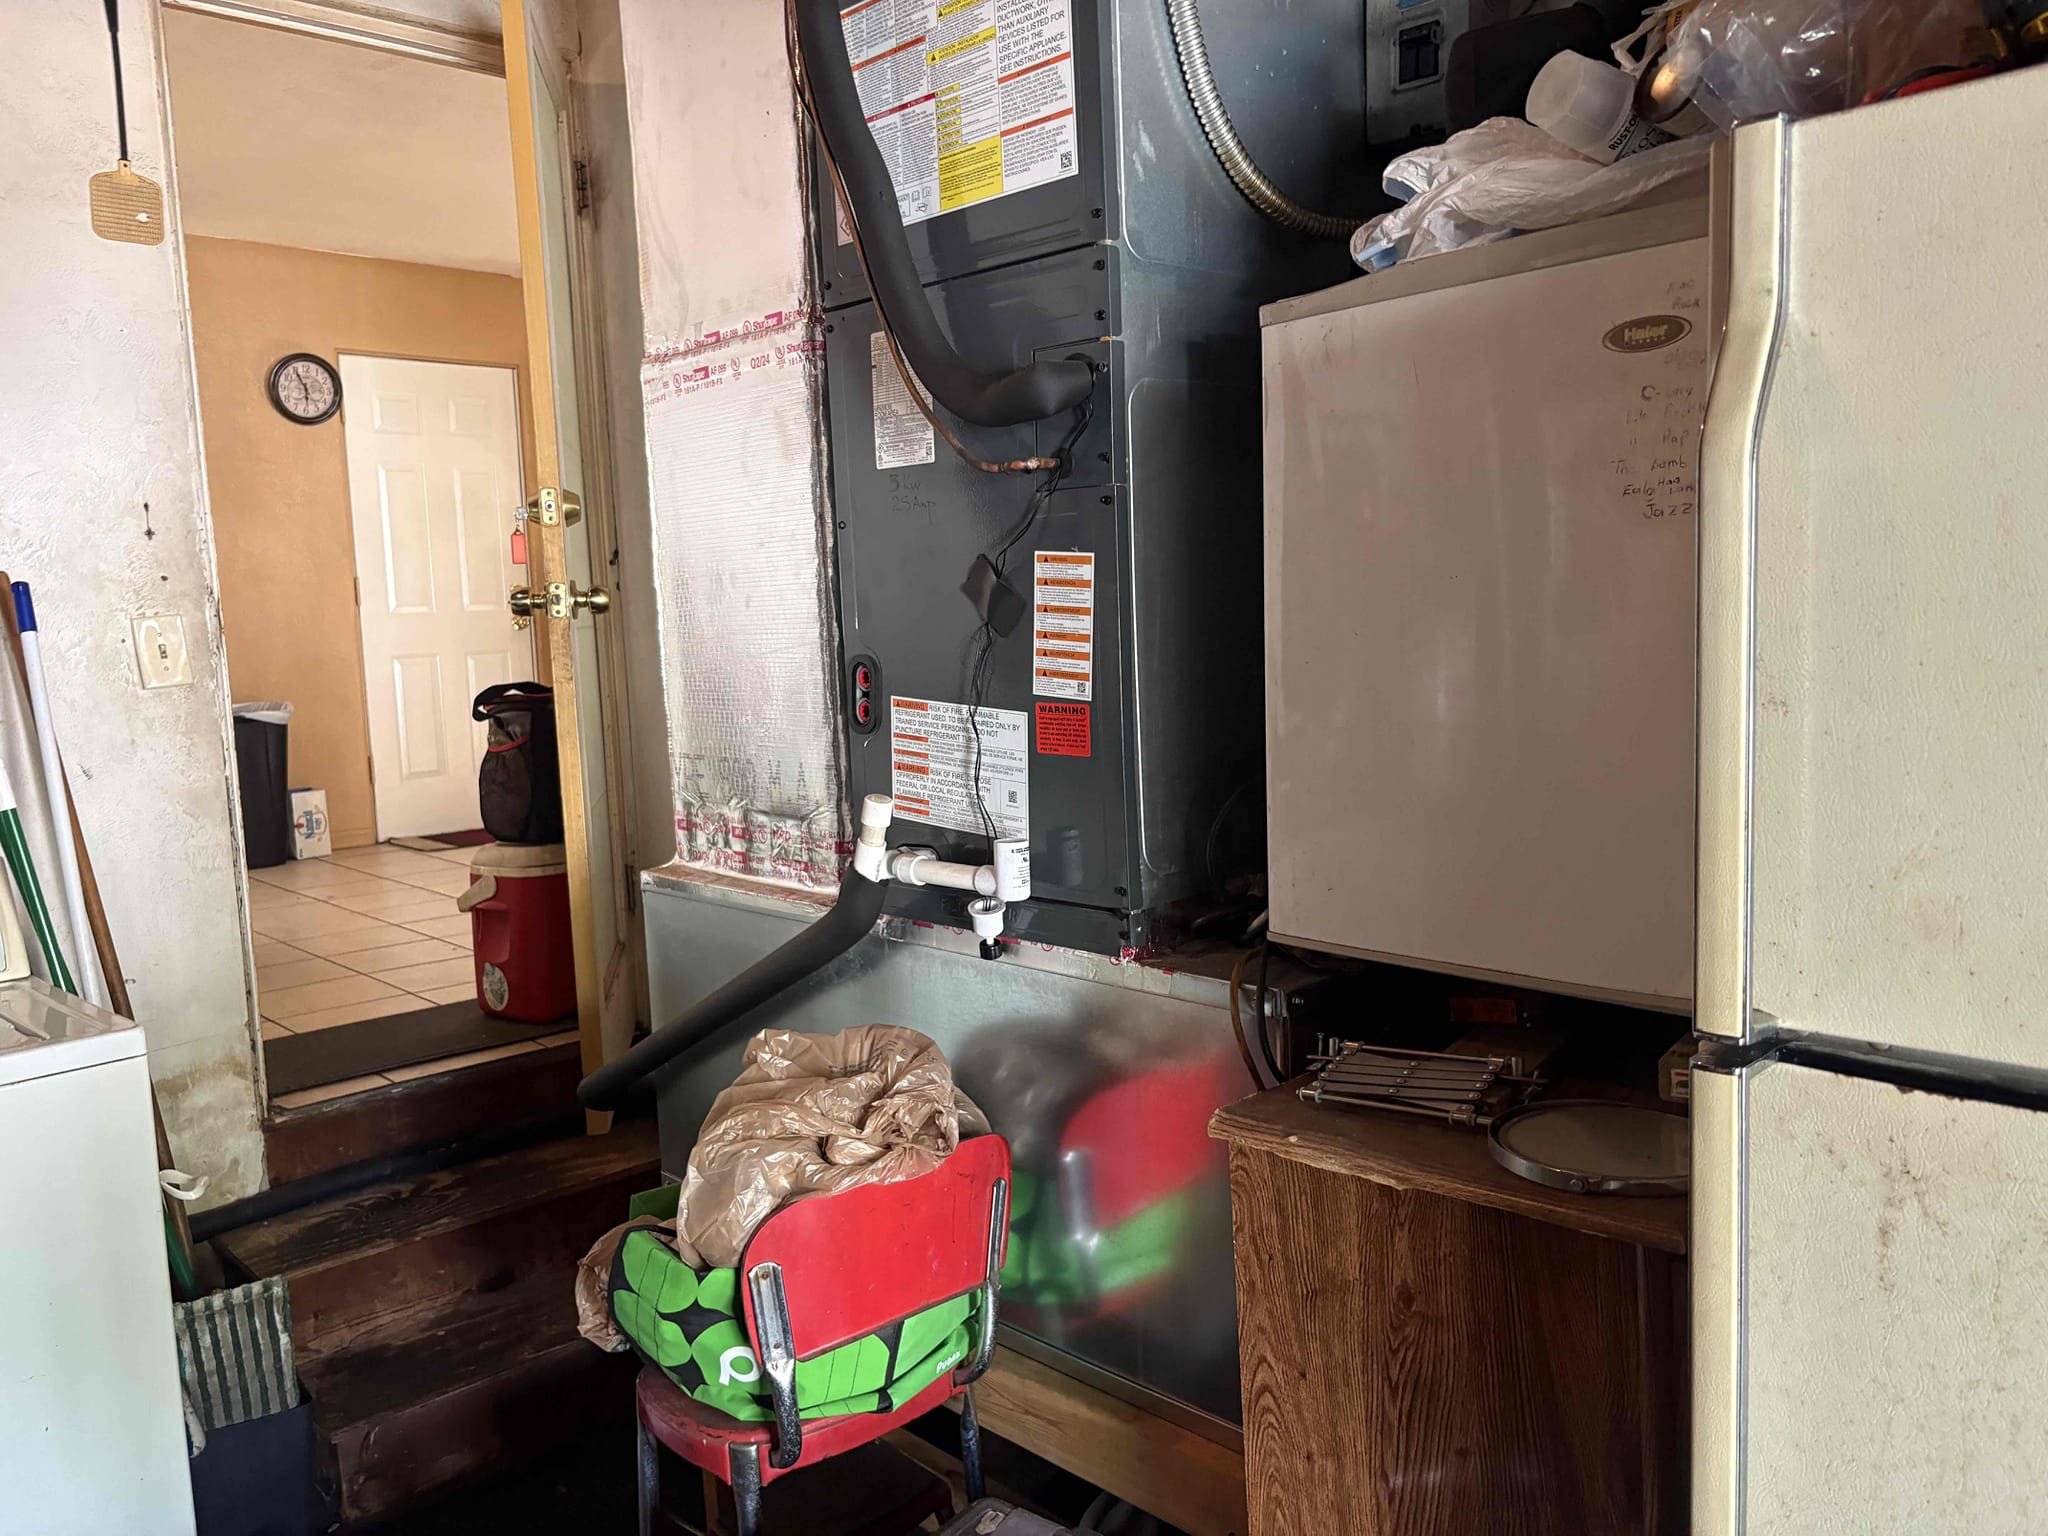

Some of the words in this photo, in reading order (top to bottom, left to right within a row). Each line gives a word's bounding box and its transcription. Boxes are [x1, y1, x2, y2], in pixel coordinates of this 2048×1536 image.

[998, 21, 1015, 32] THAN
[1016, 6, 1049, 26] AUXILIARY
[998, 26, 1026, 44] DEVICES
[1026, 16, 1050, 32] LISTED
[1050, 10, 1065, 23] FOR
[998, 42, 1012, 54] USE
[1012, 35, 1030, 48] WITH
[1031, 29, 1044, 40] THE
[999, 46, 1028, 64] SPECIFIC
[1000, 63, 1013, 74] SEE
[1624, 324, 1668, 340] Haier
[302, 364, 311, 373] 12
[280, 383, 286, 392] 9
[322, 376, 328, 385] 2
[326, 387, 332, 396] 3
[293, 403, 298, 411] 7
[929, 703, 941, 714] RISK
[942, 706, 950, 715] OF
[1039, 705, 1087, 716] WARNING
[895, 710, 931, 721] REFRIGERANT
[948, 715, 956, 723] TO
[995, 721, 1012, 731] ONLY
[1012, 723, 1021, 732] BY
[895, 717, 917, 727] TRAINED
[917, 719, 940, 730] SERVICE
[985, 729, 999, 739] NOT
[894, 725, 924, 737] PUNCTURE
[924, 729, 961, 741] REFRIGERANT
[901, 764, 926, 775] WARNING
[930, 768, 942, 778] RISK
[943, 771, 951, 779] OF
[896, 779, 919, 790] FEDERAL
[919, 783, 928, 792] OR
[928, 785, 946, 795] LOCAL
[930, 777, 935, 785] IN
[935, 777, 974, 791] ACCORDANCE
[896, 787, 927, 799] FLAMMABLE
[926, 792, 965, 806] REFRIGERANT
